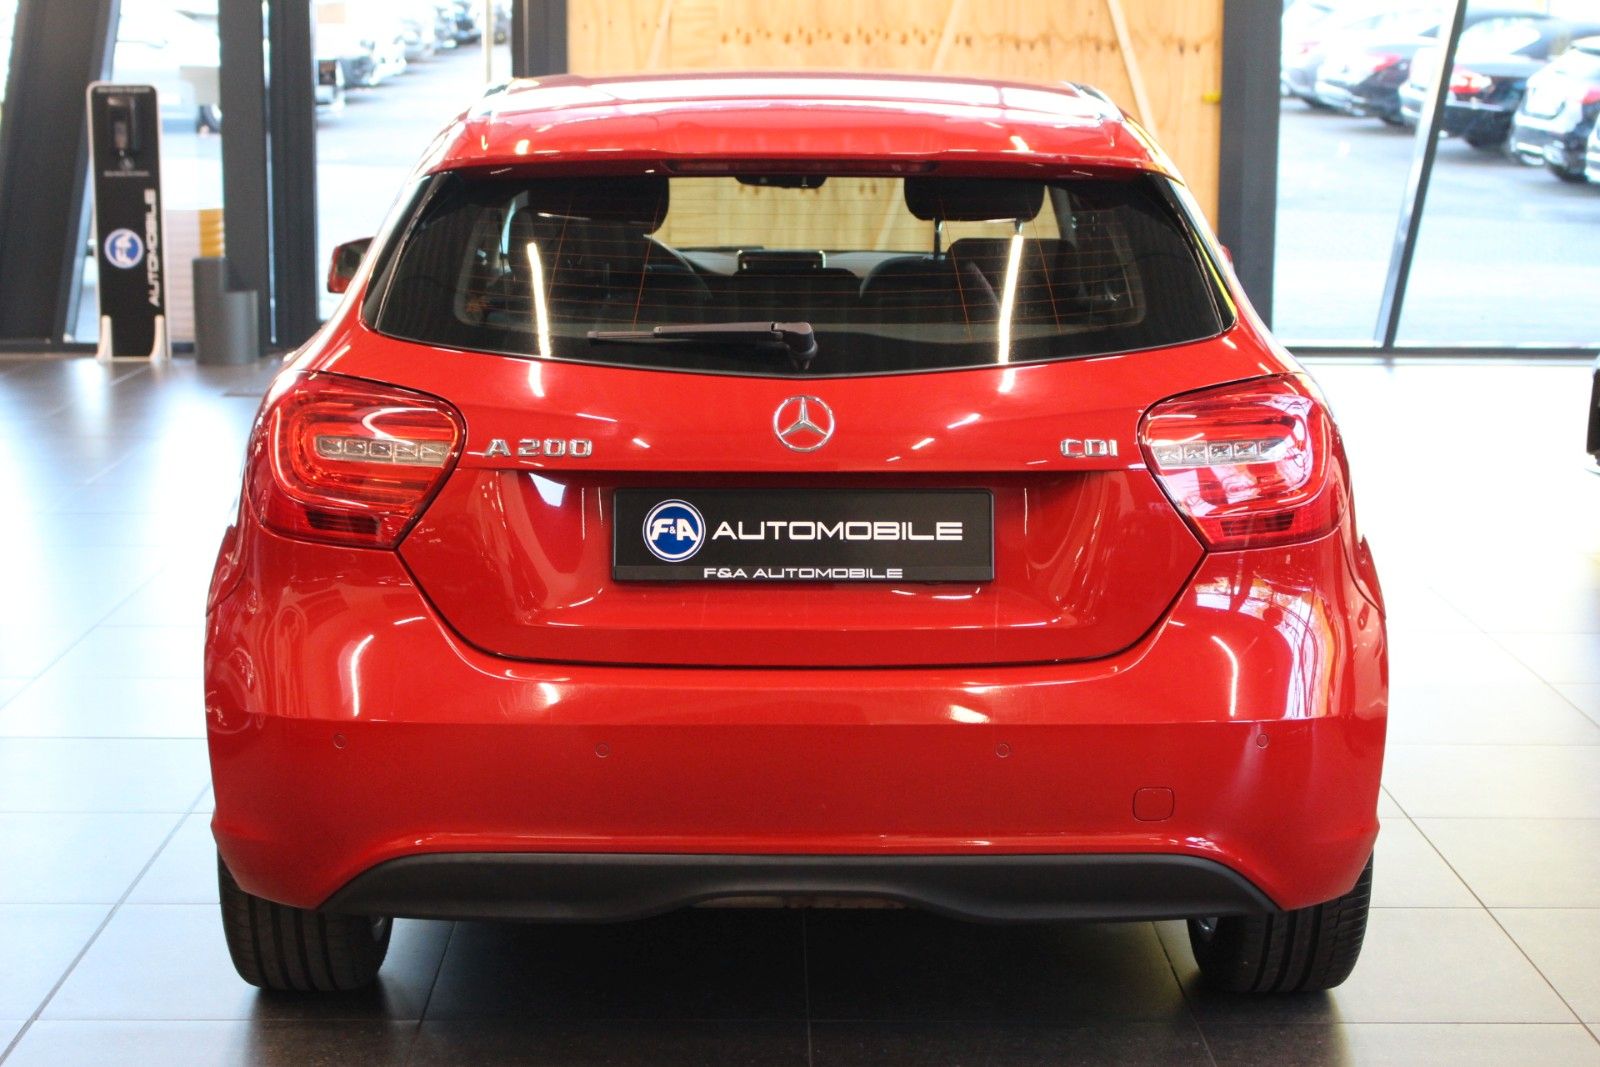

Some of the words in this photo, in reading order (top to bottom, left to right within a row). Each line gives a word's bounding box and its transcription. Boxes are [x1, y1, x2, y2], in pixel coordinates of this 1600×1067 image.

[144, 189, 160, 307] AUTOMOBILE
[485, 438, 512, 457] A
[517, 438, 593, 457] 200
[1060, 438, 1118, 457] CDI
[651, 518, 698, 541] F&A
[712, 521, 963, 541] AUTOMOBILE
[704, 567, 747, 579] F&A
[753, 567, 903, 579] AUTOMOBILE
